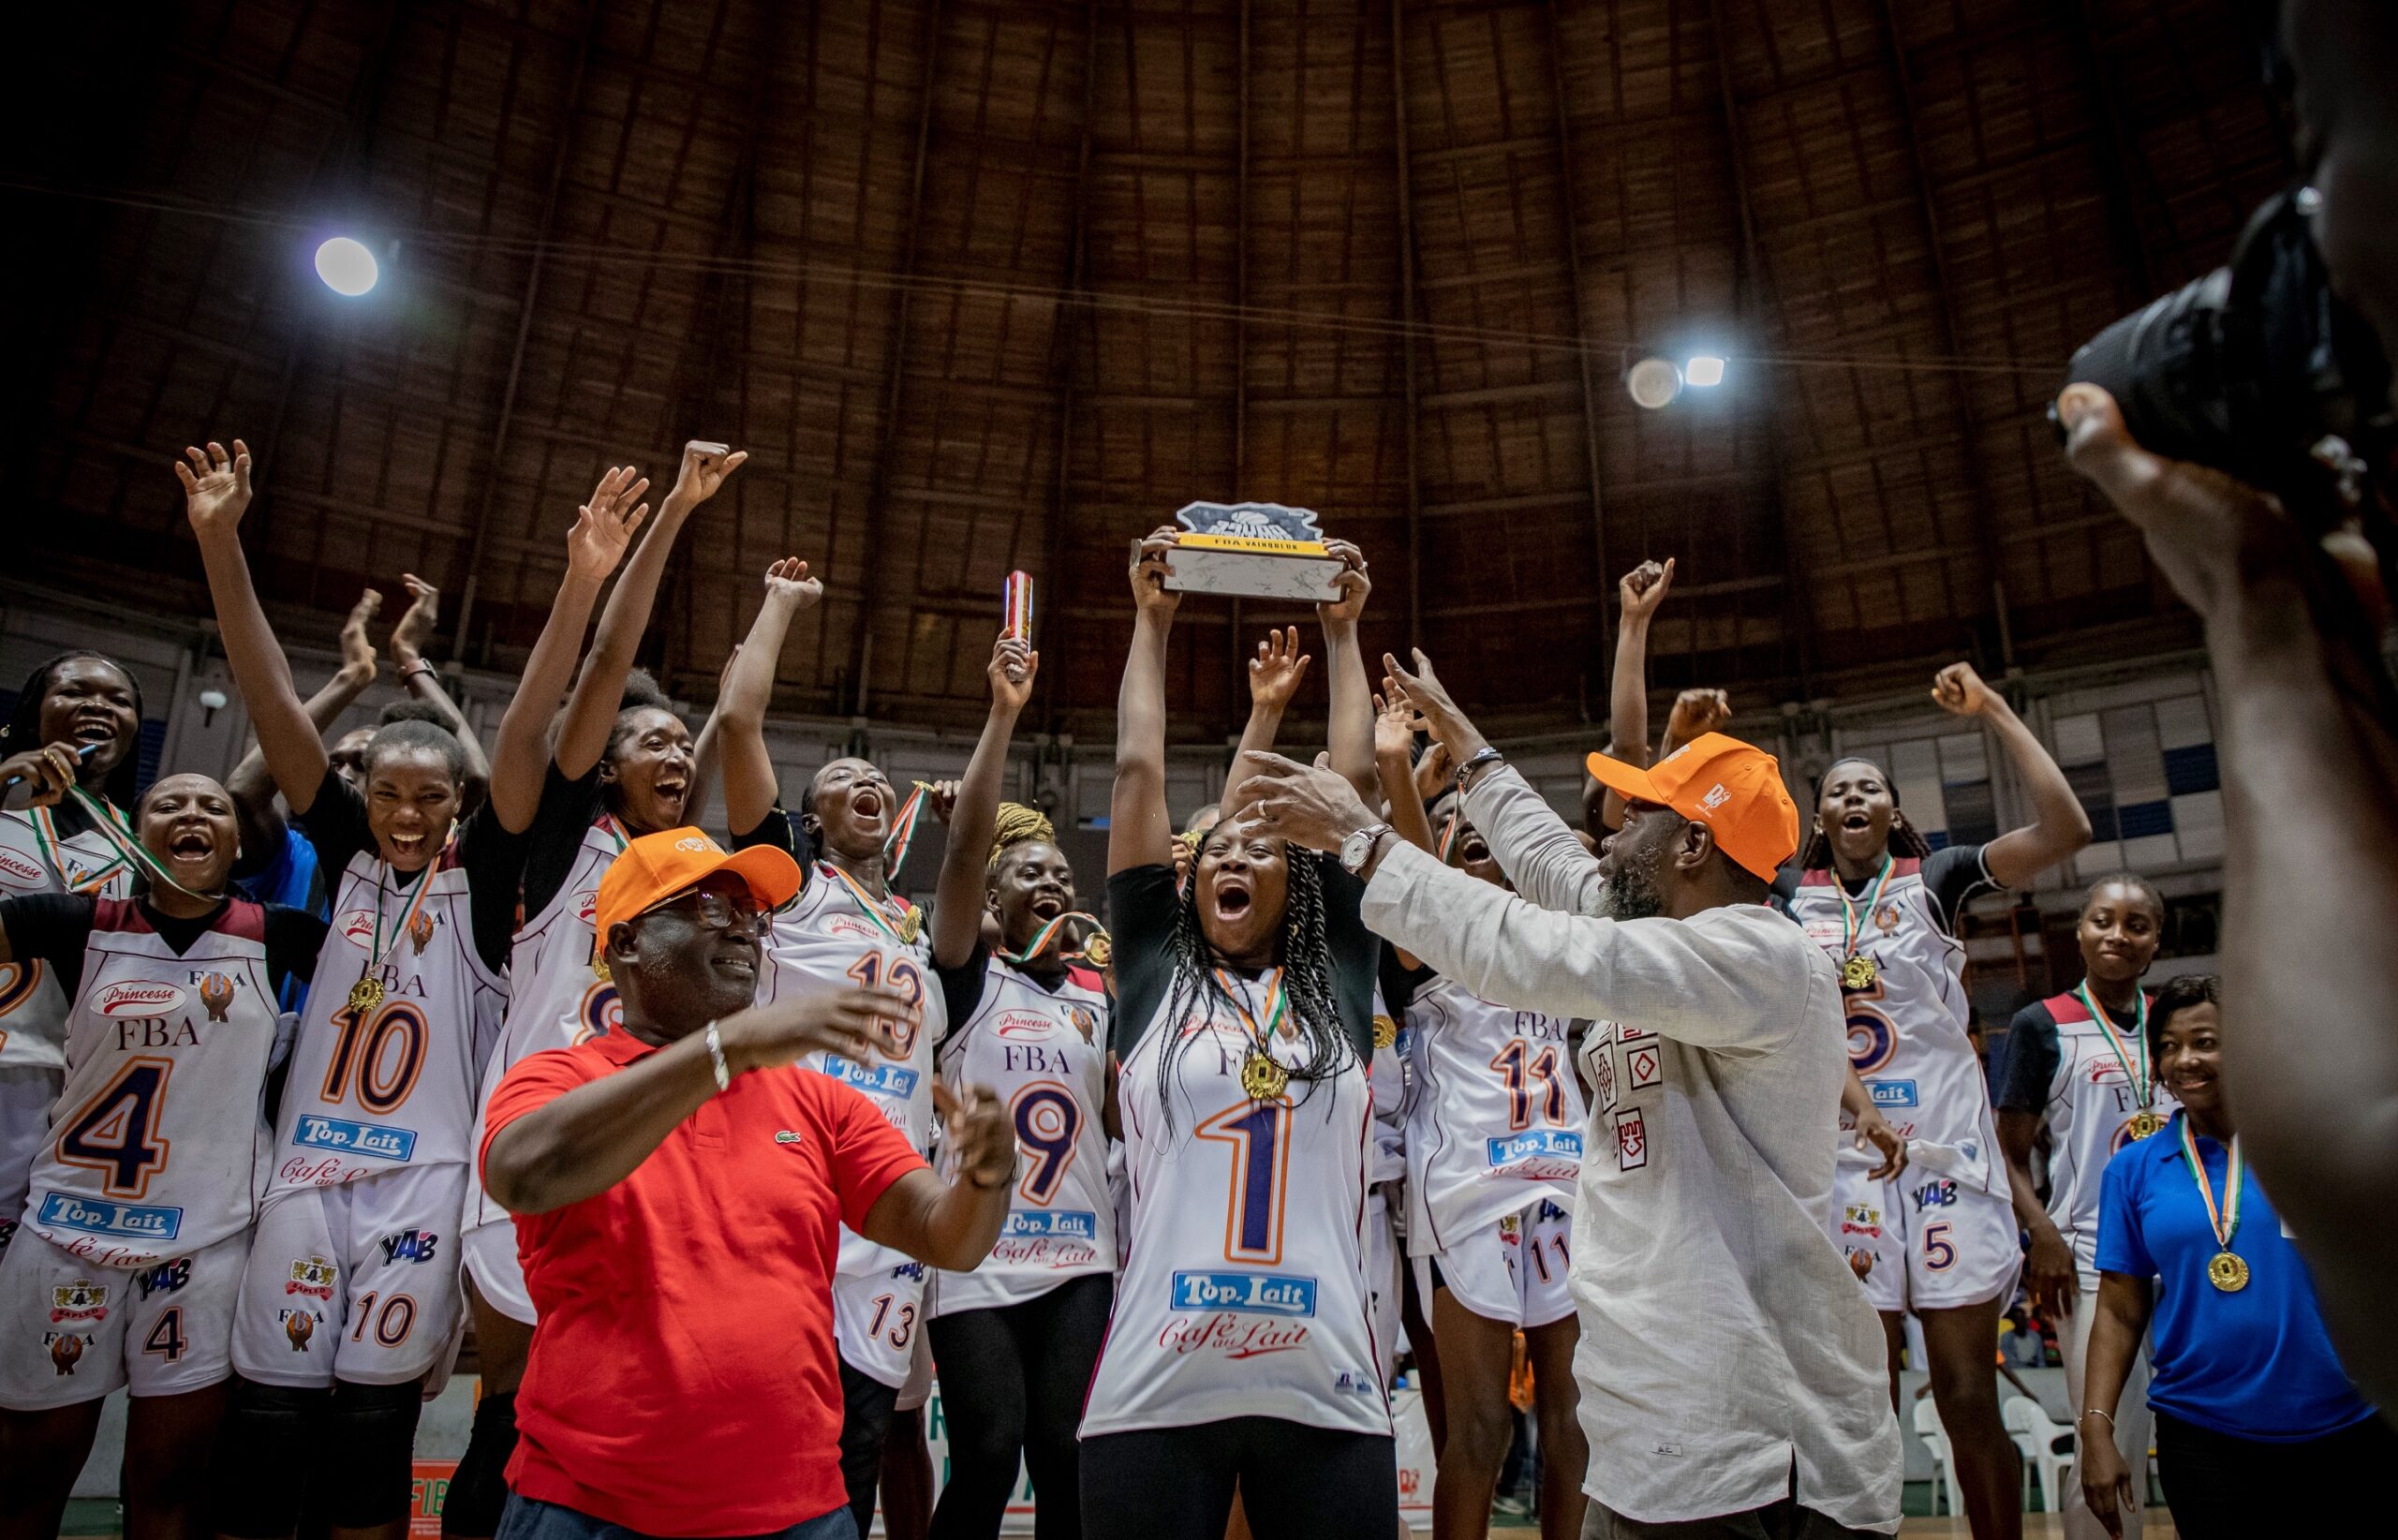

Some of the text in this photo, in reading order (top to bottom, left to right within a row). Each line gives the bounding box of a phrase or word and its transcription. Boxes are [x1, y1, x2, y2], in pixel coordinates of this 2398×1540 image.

[830, 914, 881, 938] Princesse
[103, 985, 176, 1004] Princesse
[188, 970, 247, 997] FBA
[116, 1015, 201, 1051] FBA
[999, 1013, 1053, 1029] Princesse
[1514, 1010, 1565, 1042] FBA
[1839, 975, 1899, 1076] 5
[319, 1000, 430, 1116] 10
[1004, 1044, 1073, 1074] FBA
[1489, 1039, 1565, 1131] 11
[56, 1055, 174, 1200] 4
[349, 1126, 402, 1156] Lait
[1009, 1080, 1085, 1207] 9
[1544, 1133, 1580, 1157] Lait
[280, 1156, 341, 1185] Café
[1194, 1094, 1293, 1266] 1
[1912, 1179, 1958, 1214] YAB
[107, 1207, 167, 1236] Lait
[1046, 1213, 1088, 1236] Lait
[378, 1227, 438, 1266] YAB
[993, 1237, 1049, 1265] Café
[1053, 1244, 1096, 1264] Lait
[1923, 1221, 1959, 1272] 5
[137, 1258, 193, 1301] YAB
[291, 1282, 326, 1295] SAPLED
[1243, 1277, 1306, 1311] Lait
[57, 1308, 99, 1320] SAPLED
[278, 1309, 324, 1331] FBA
[352, 1291, 418, 1349] 10
[869, 1293, 915, 1351] 13
[43, 1331, 96, 1355] FBA
[142, 1306, 188, 1364] 4
[1159, 1312, 1237, 1355] Café
[1236, 1319, 1310, 1351] Lait
